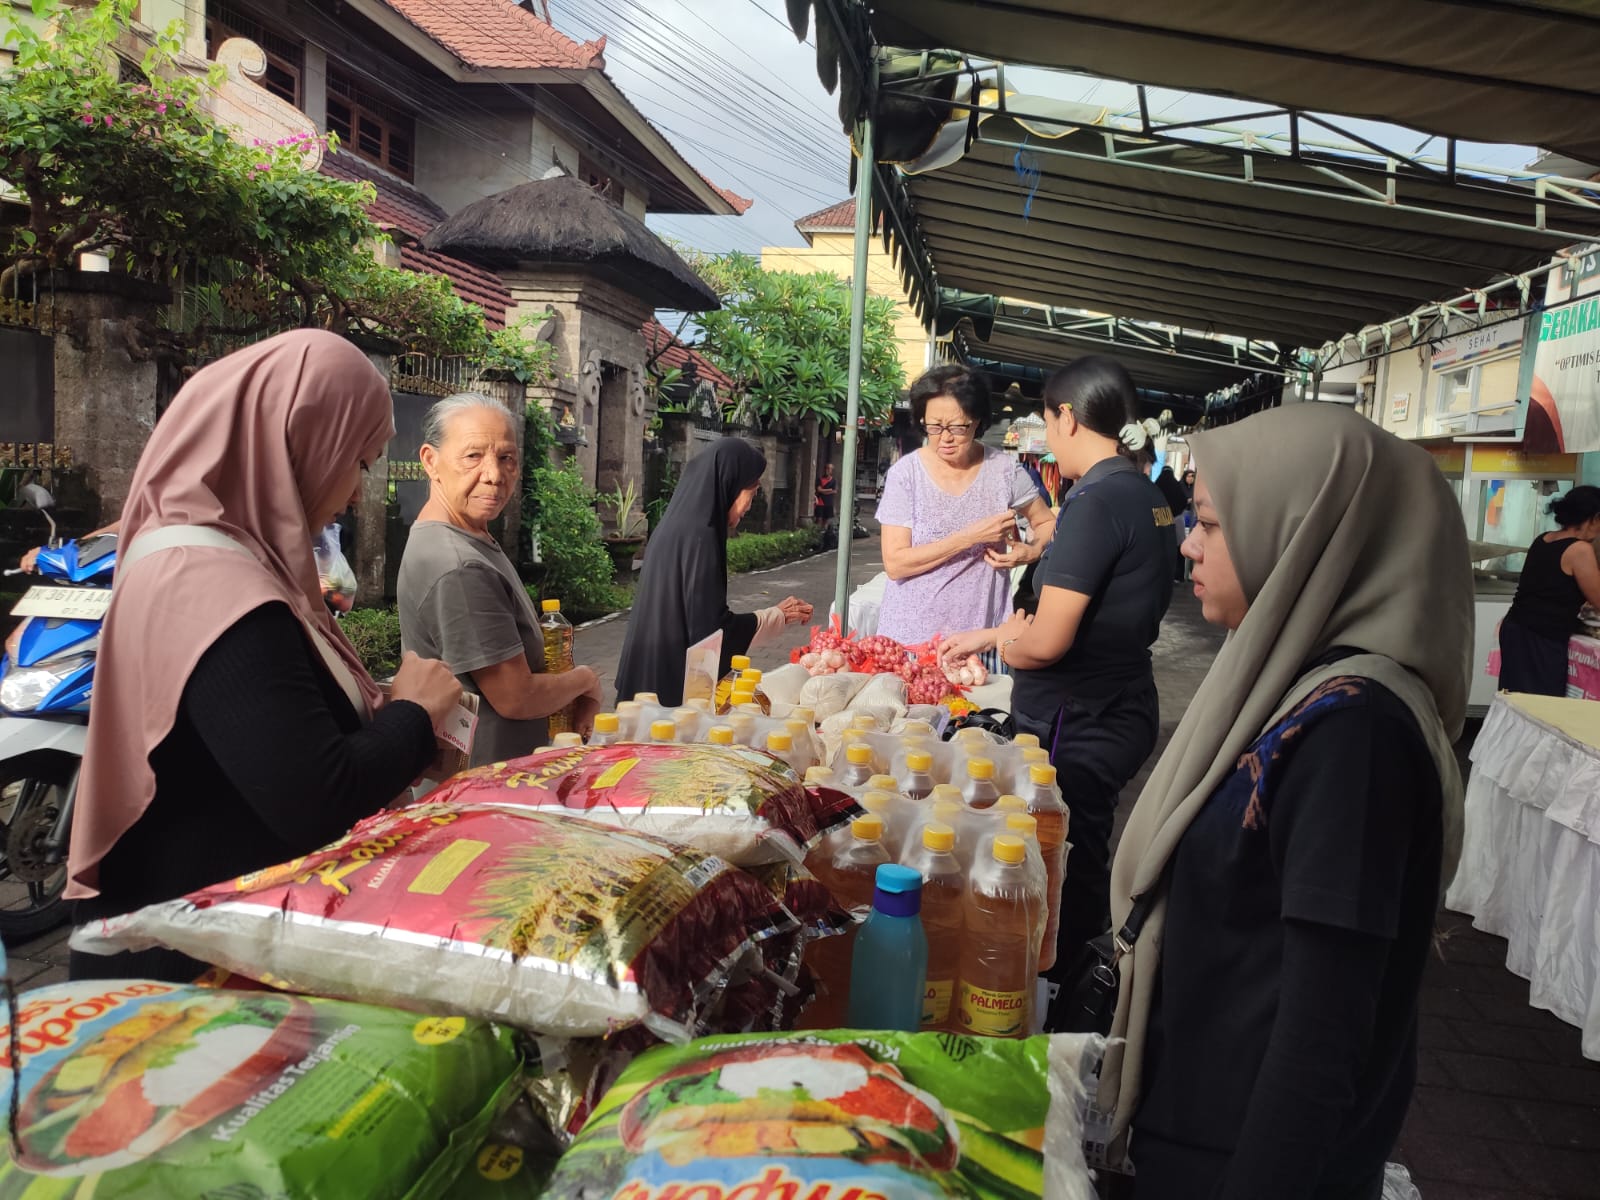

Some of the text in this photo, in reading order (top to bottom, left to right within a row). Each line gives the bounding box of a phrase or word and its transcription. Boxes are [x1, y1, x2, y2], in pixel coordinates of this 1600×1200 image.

[1540, 297, 1600, 342] GERAKA
[1468, 330, 1498, 350] SEHAT
[970, 993, 1023, 1010] PALMELO
[211, 1074, 296, 1142] Kualitas
[284, 1023, 361, 1076] Terjamin
